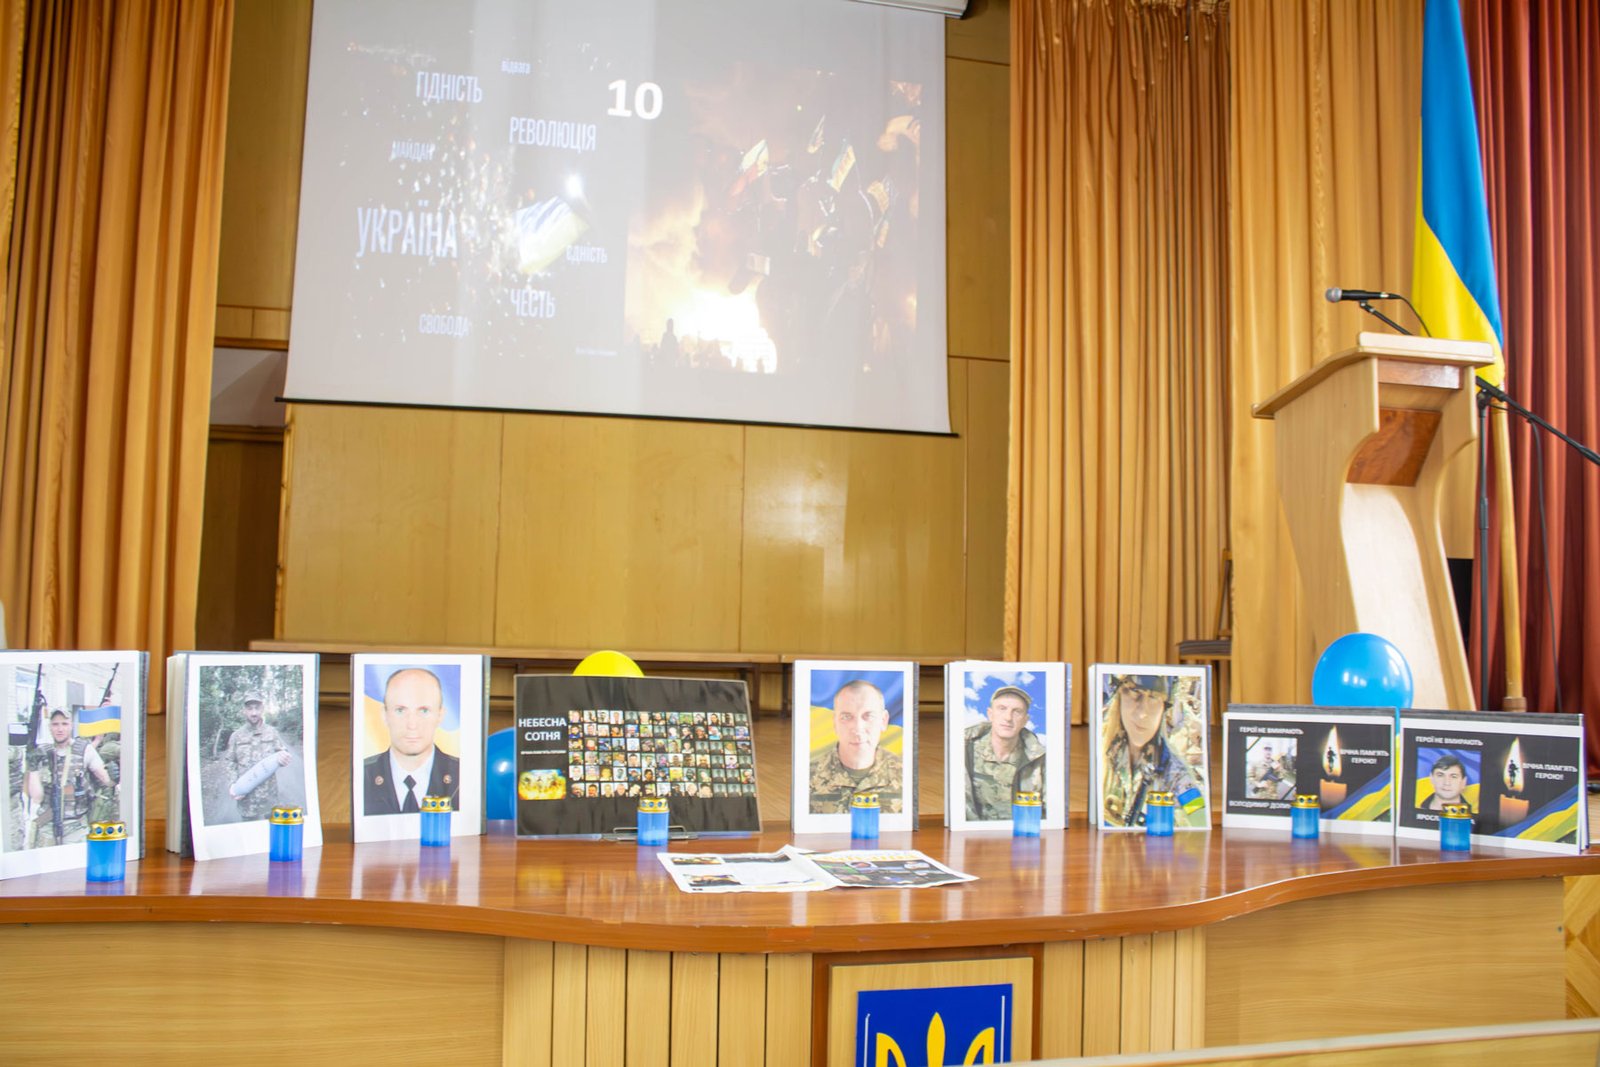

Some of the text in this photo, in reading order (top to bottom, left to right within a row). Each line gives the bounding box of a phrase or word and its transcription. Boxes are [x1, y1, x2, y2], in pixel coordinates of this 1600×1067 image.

[416, 71, 483, 104] ГІДНІСТЬ
[606, 79, 664, 120] 10
[508, 116, 597, 152] РЕВОЛЮЦІЯ
[390, 139, 436, 161] МАЙДАН
[355, 199, 458, 258] УКРАЇНА
[510, 287, 556, 318] ЧЕСТЬ
[418, 313, 470, 339] СВОБОДА
[518, 717, 567, 728] НЕБЕСНА
[524, 731, 561, 742] СОТНЯ
